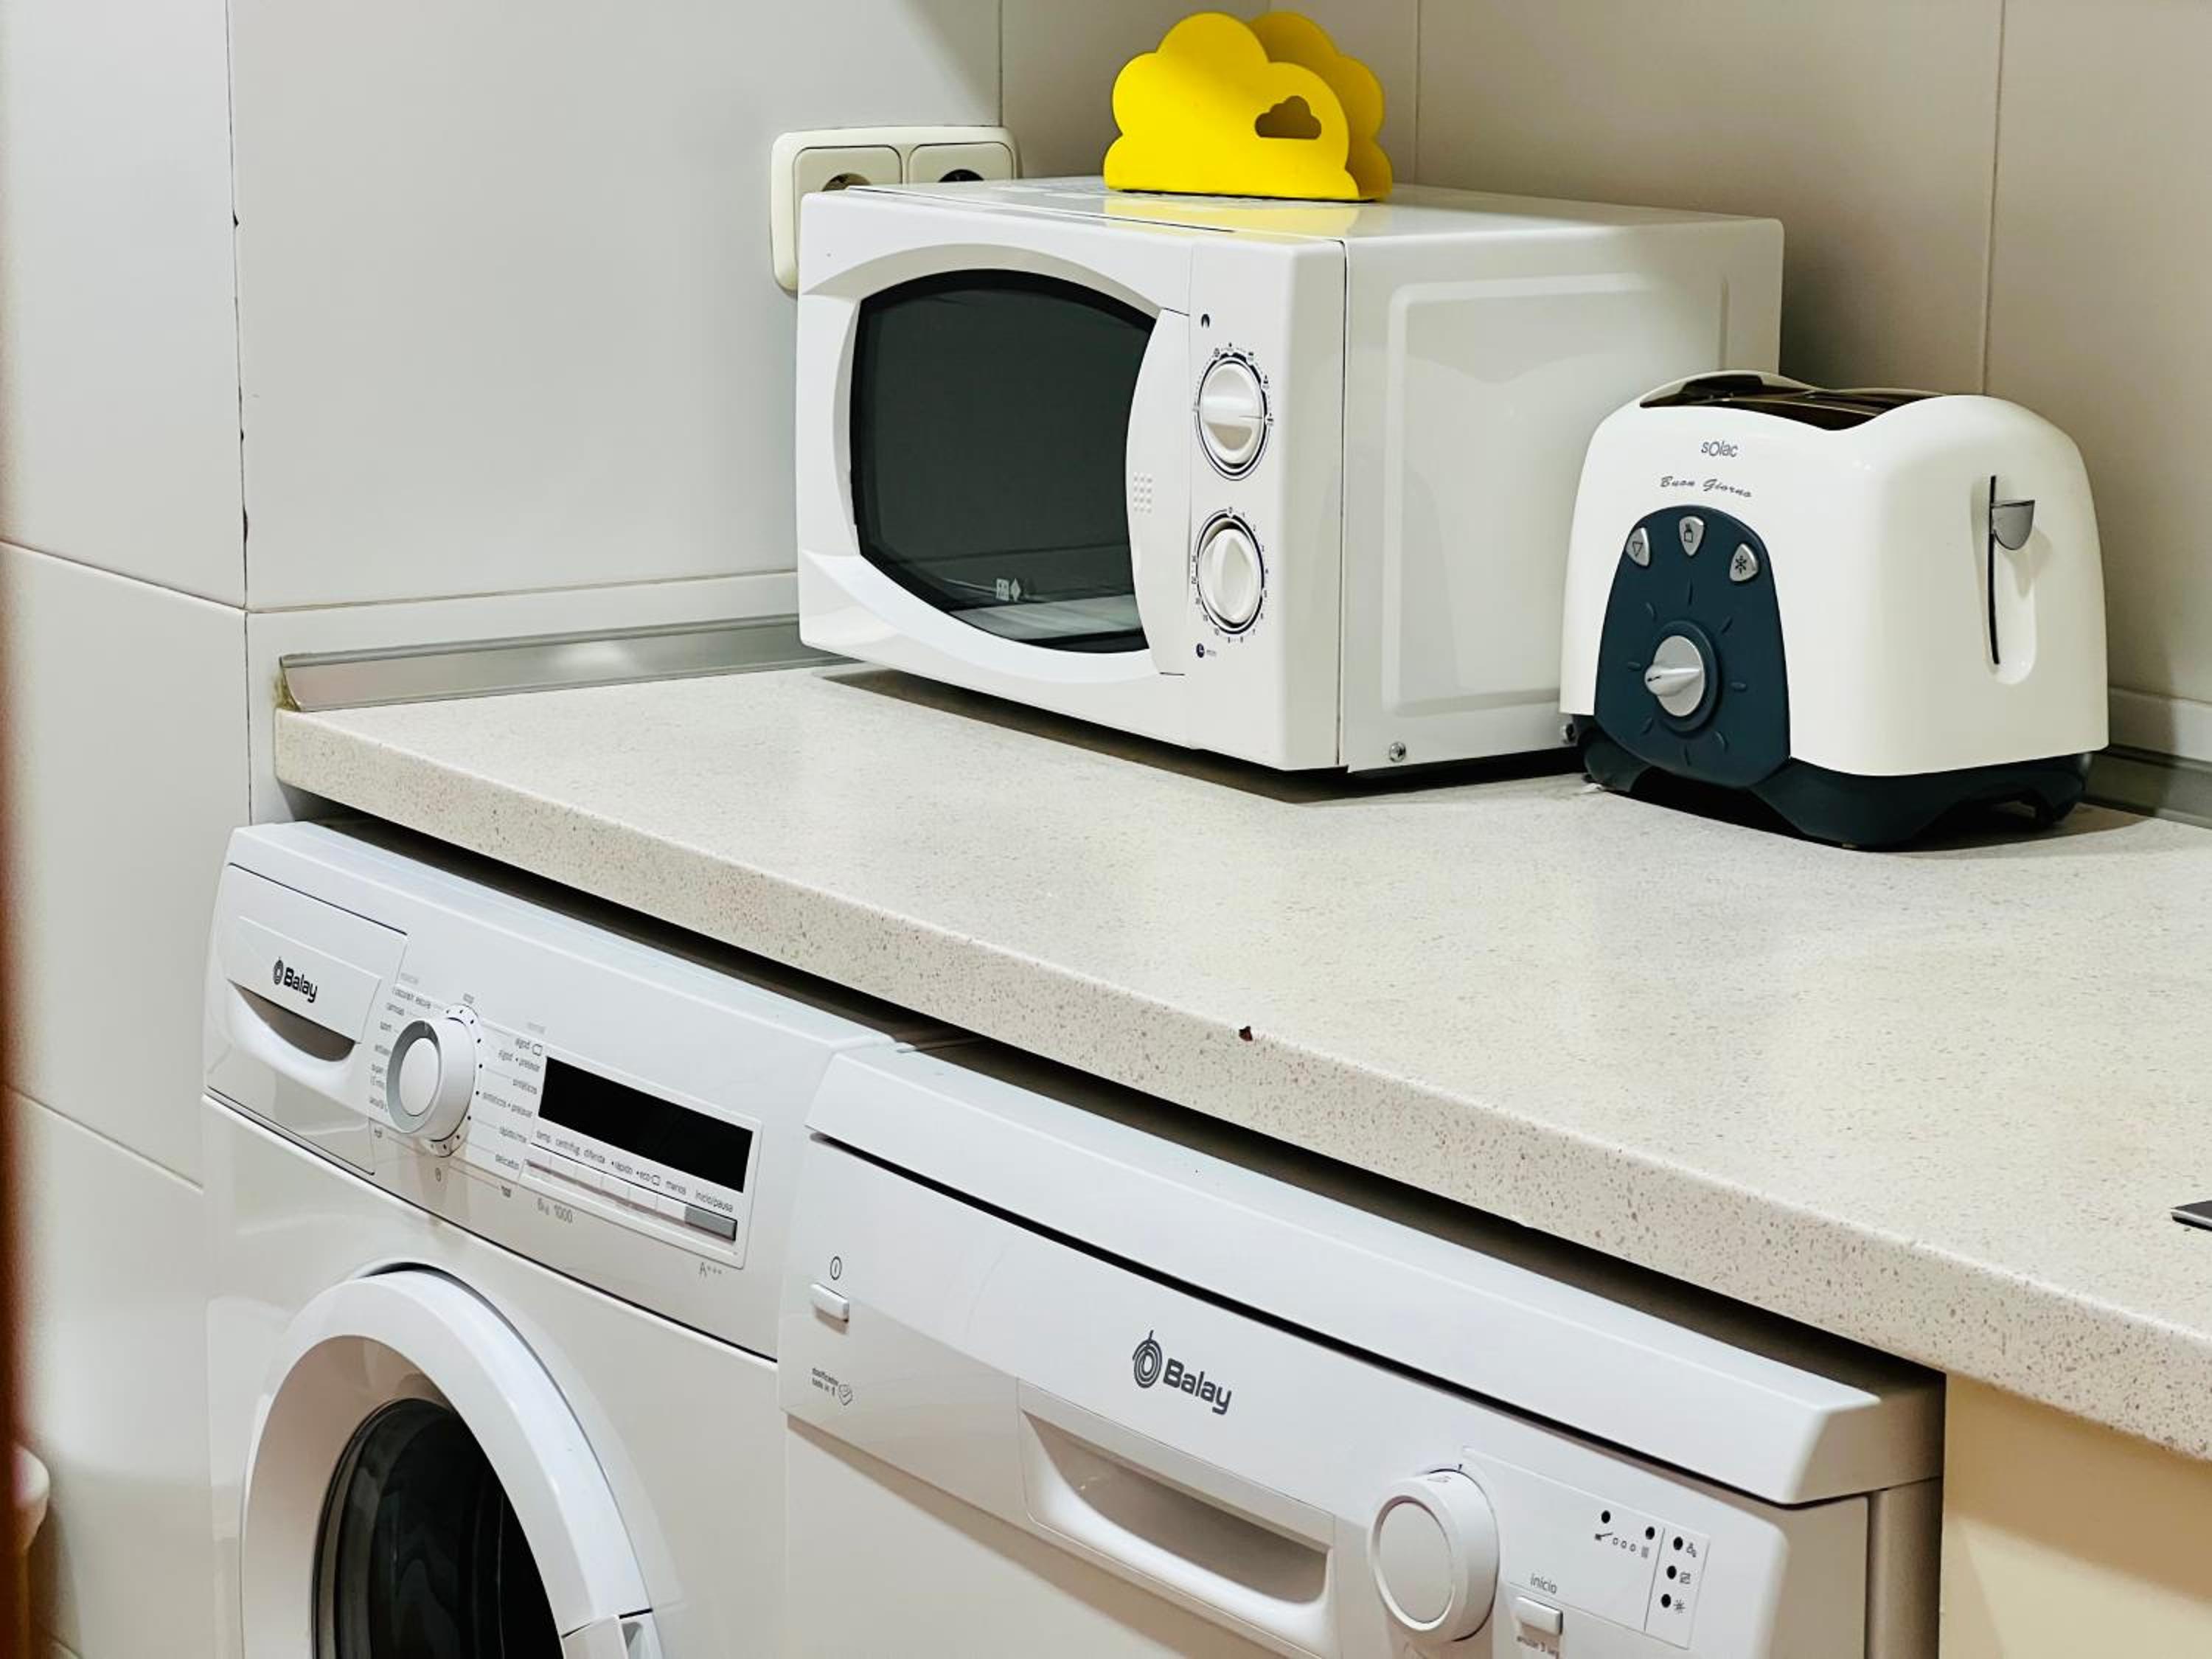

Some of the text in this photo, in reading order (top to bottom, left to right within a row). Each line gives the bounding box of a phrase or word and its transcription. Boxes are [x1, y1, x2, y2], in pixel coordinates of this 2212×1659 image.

[1660, 476, 1752, 498] Buon Giorno
[283, 967, 318, 1003] Balay
[1163, 1357, 1232, 1415] Balay
